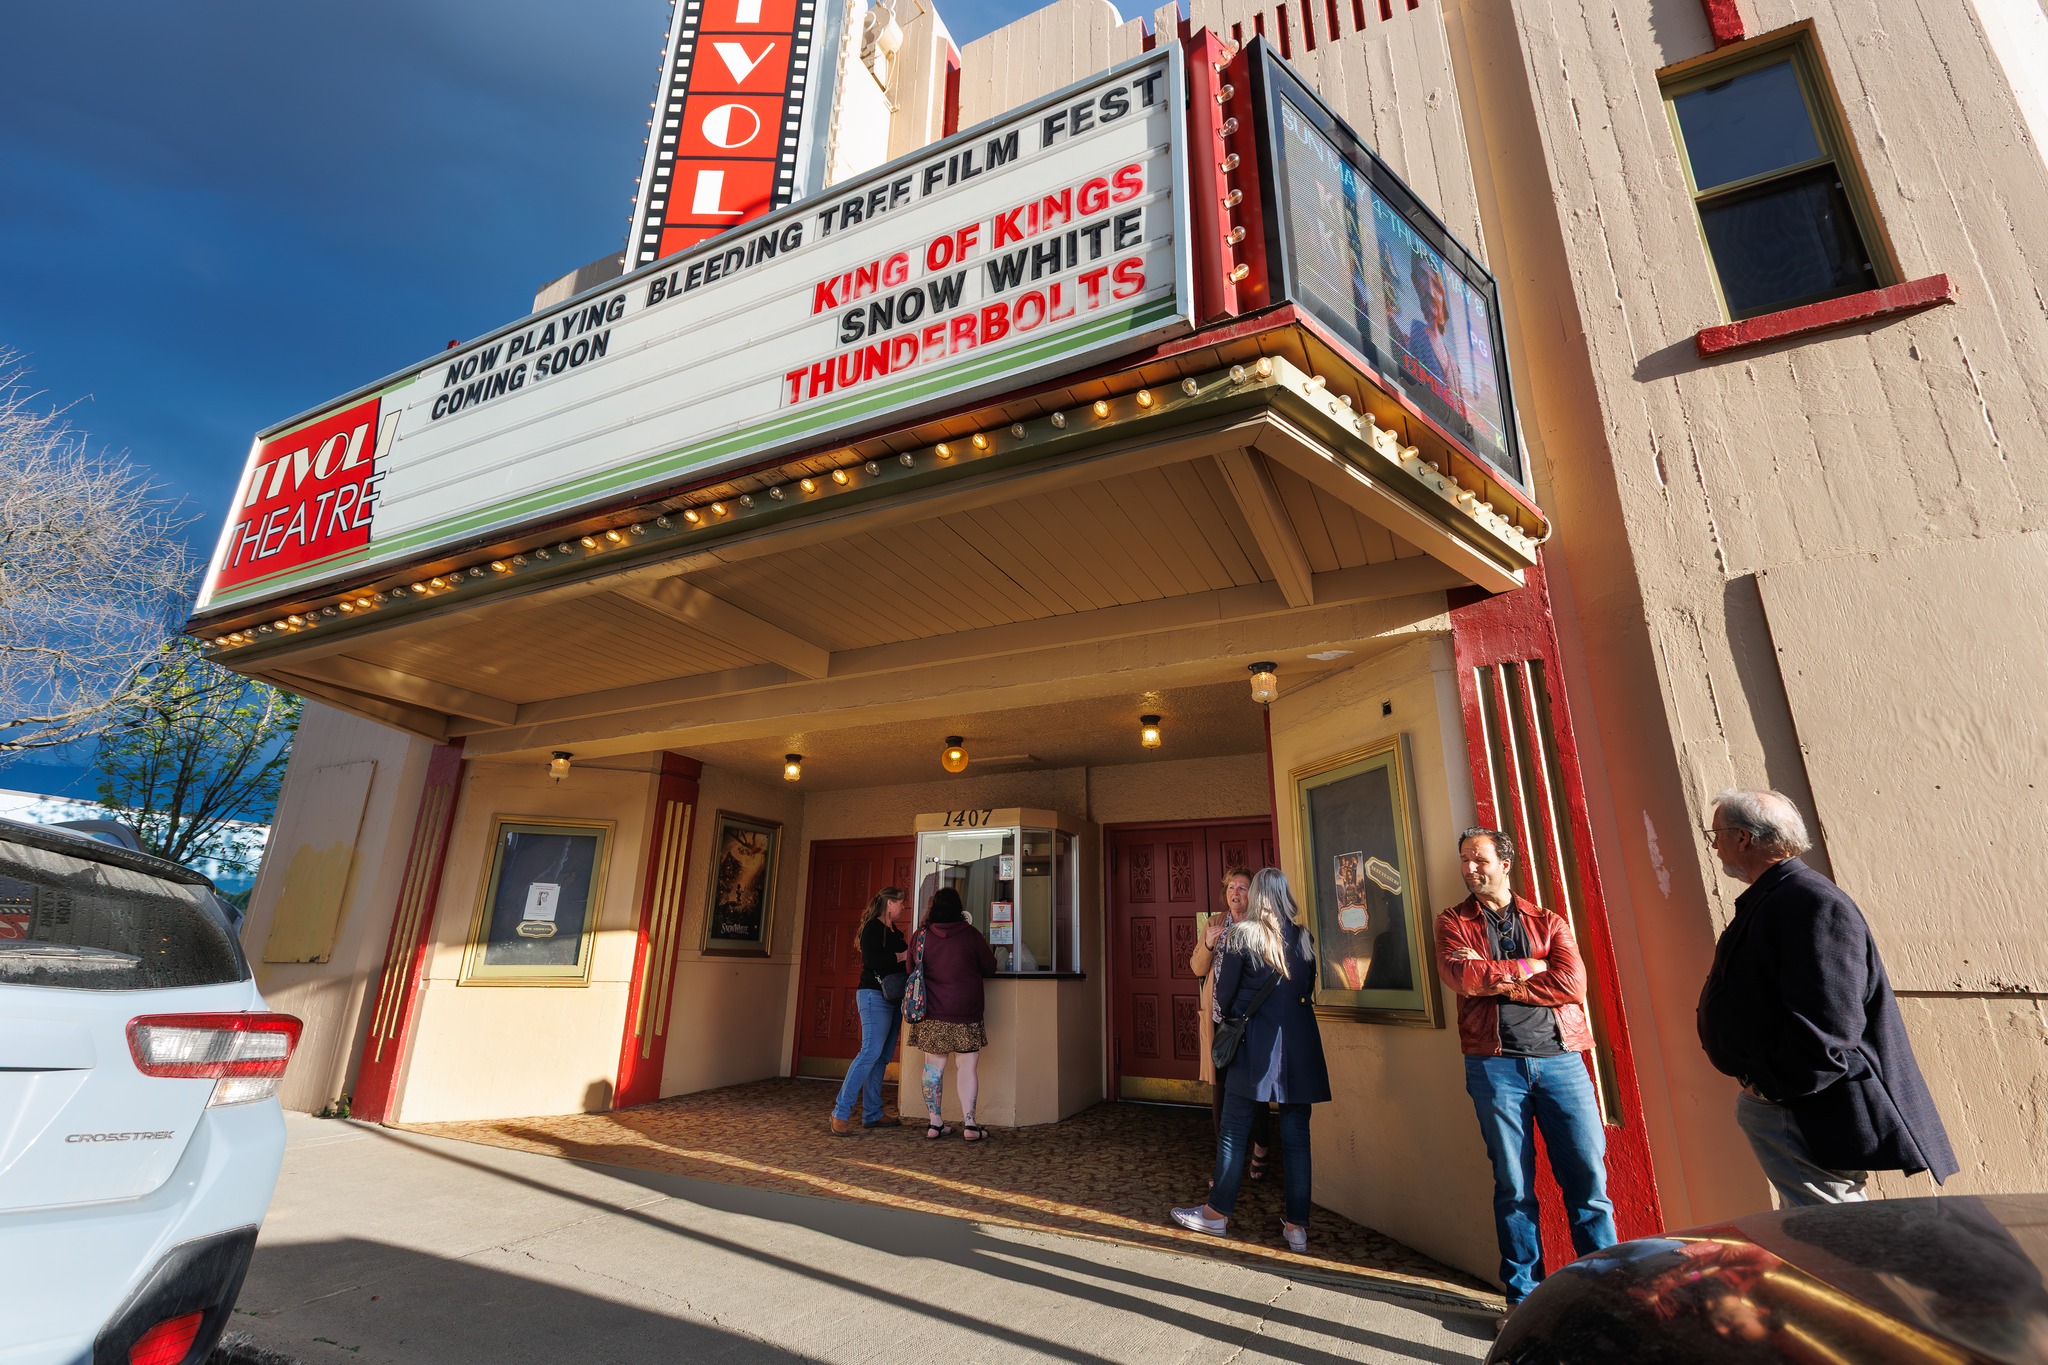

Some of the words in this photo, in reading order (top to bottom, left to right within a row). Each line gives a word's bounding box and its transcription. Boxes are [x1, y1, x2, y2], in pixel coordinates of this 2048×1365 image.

[691, 0, 776, 243] IVOL
[443, 343, 504, 389] NOW
[505, 294, 627, 363] PLAYING
[646, 221, 804, 308] BLEEDING
[818, 174, 913, 237] TREE
[922, 129, 1020, 197] FILM
[1042, 69, 1163, 148] FEST
[813, 251, 910, 315] KING
[926, 222, 980, 272] OF
[993, 163, 1144, 249] KINGS
[840, 269, 968, 344] SNOW
[986, 207, 1143, 294] WHITE
[785, 256, 1146, 405] THUNDERBOLTS
[1470, 331, 1488, 358] PG
[1475, 297, 1485, 318] 8
[431, 362, 528, 421] COMING
[533, 328, 612, 382] SOON
[243, 408, 403, 509] TIVOLI
[221, 470, 387, 572] THEATRE
[943, 809, 993, 827] 1407
[64, 1130, 176, 1144] CROSSTREK
